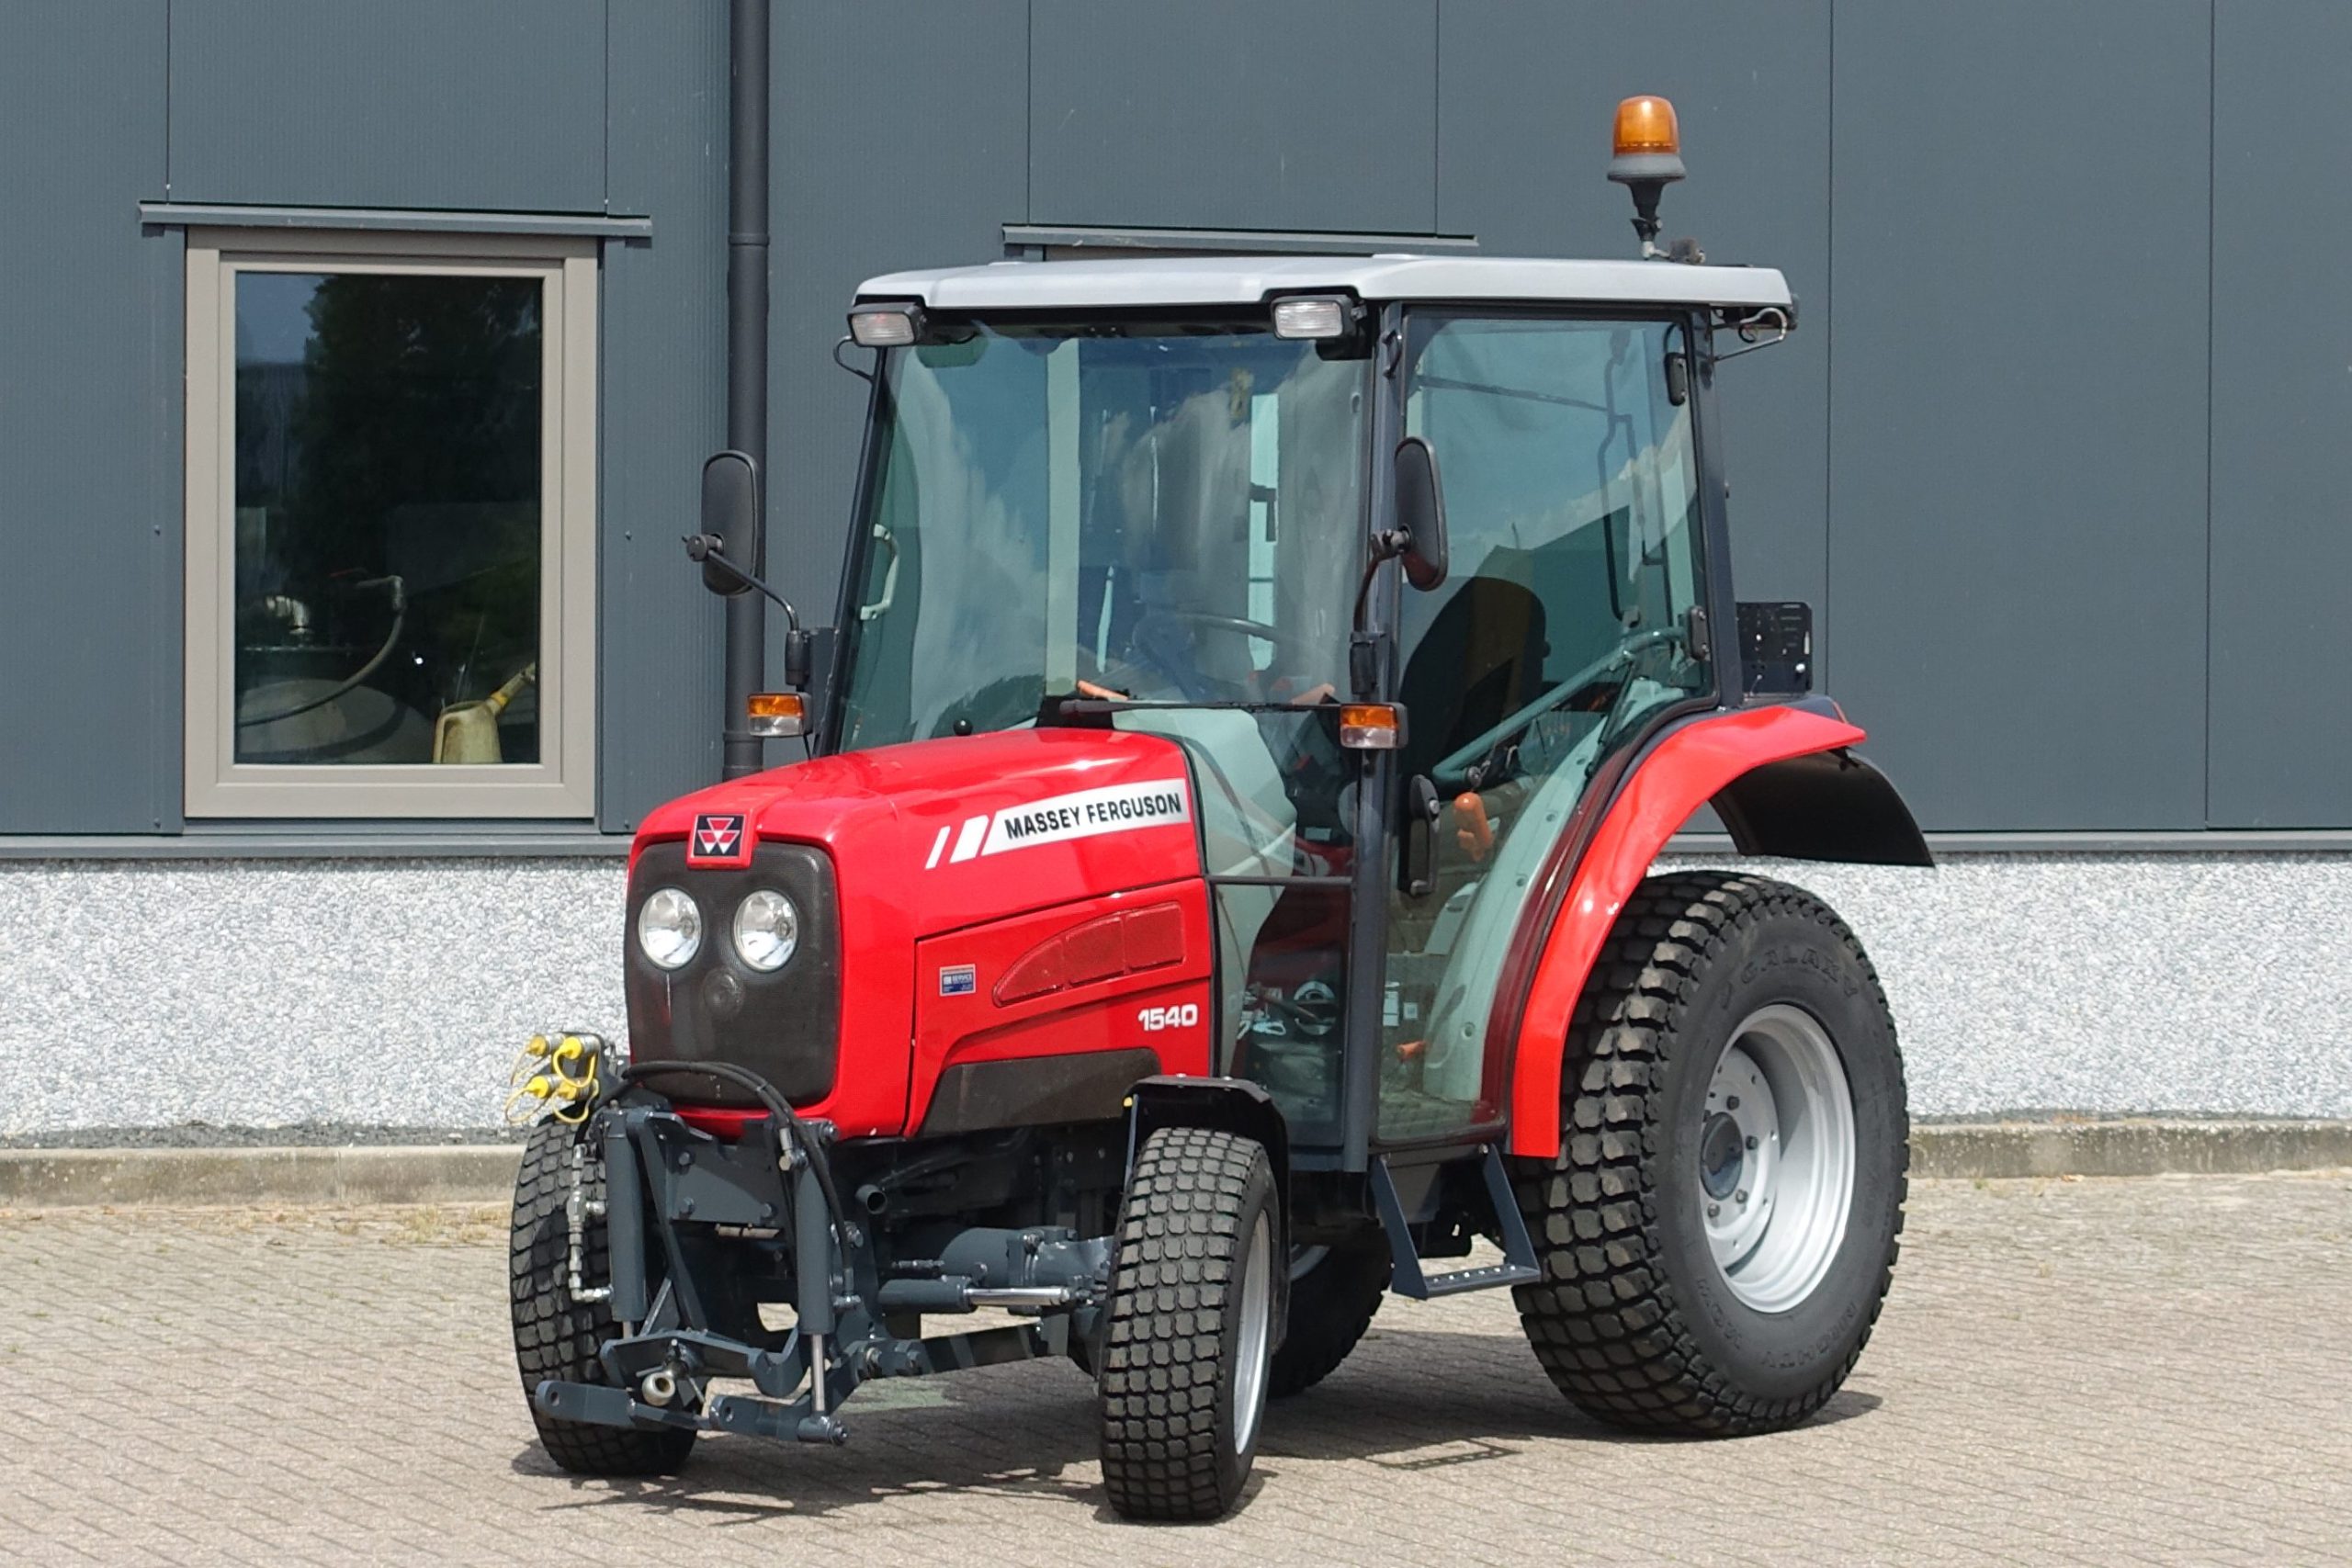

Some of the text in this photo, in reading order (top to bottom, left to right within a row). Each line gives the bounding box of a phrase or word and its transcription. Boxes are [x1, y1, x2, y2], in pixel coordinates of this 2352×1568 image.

[1004, 793, 1182, 840] MASSEY FERGUSON
[1741, 945, 1858, 998] GALAXY
[1138, 1004, 1198, 1031] 1540
